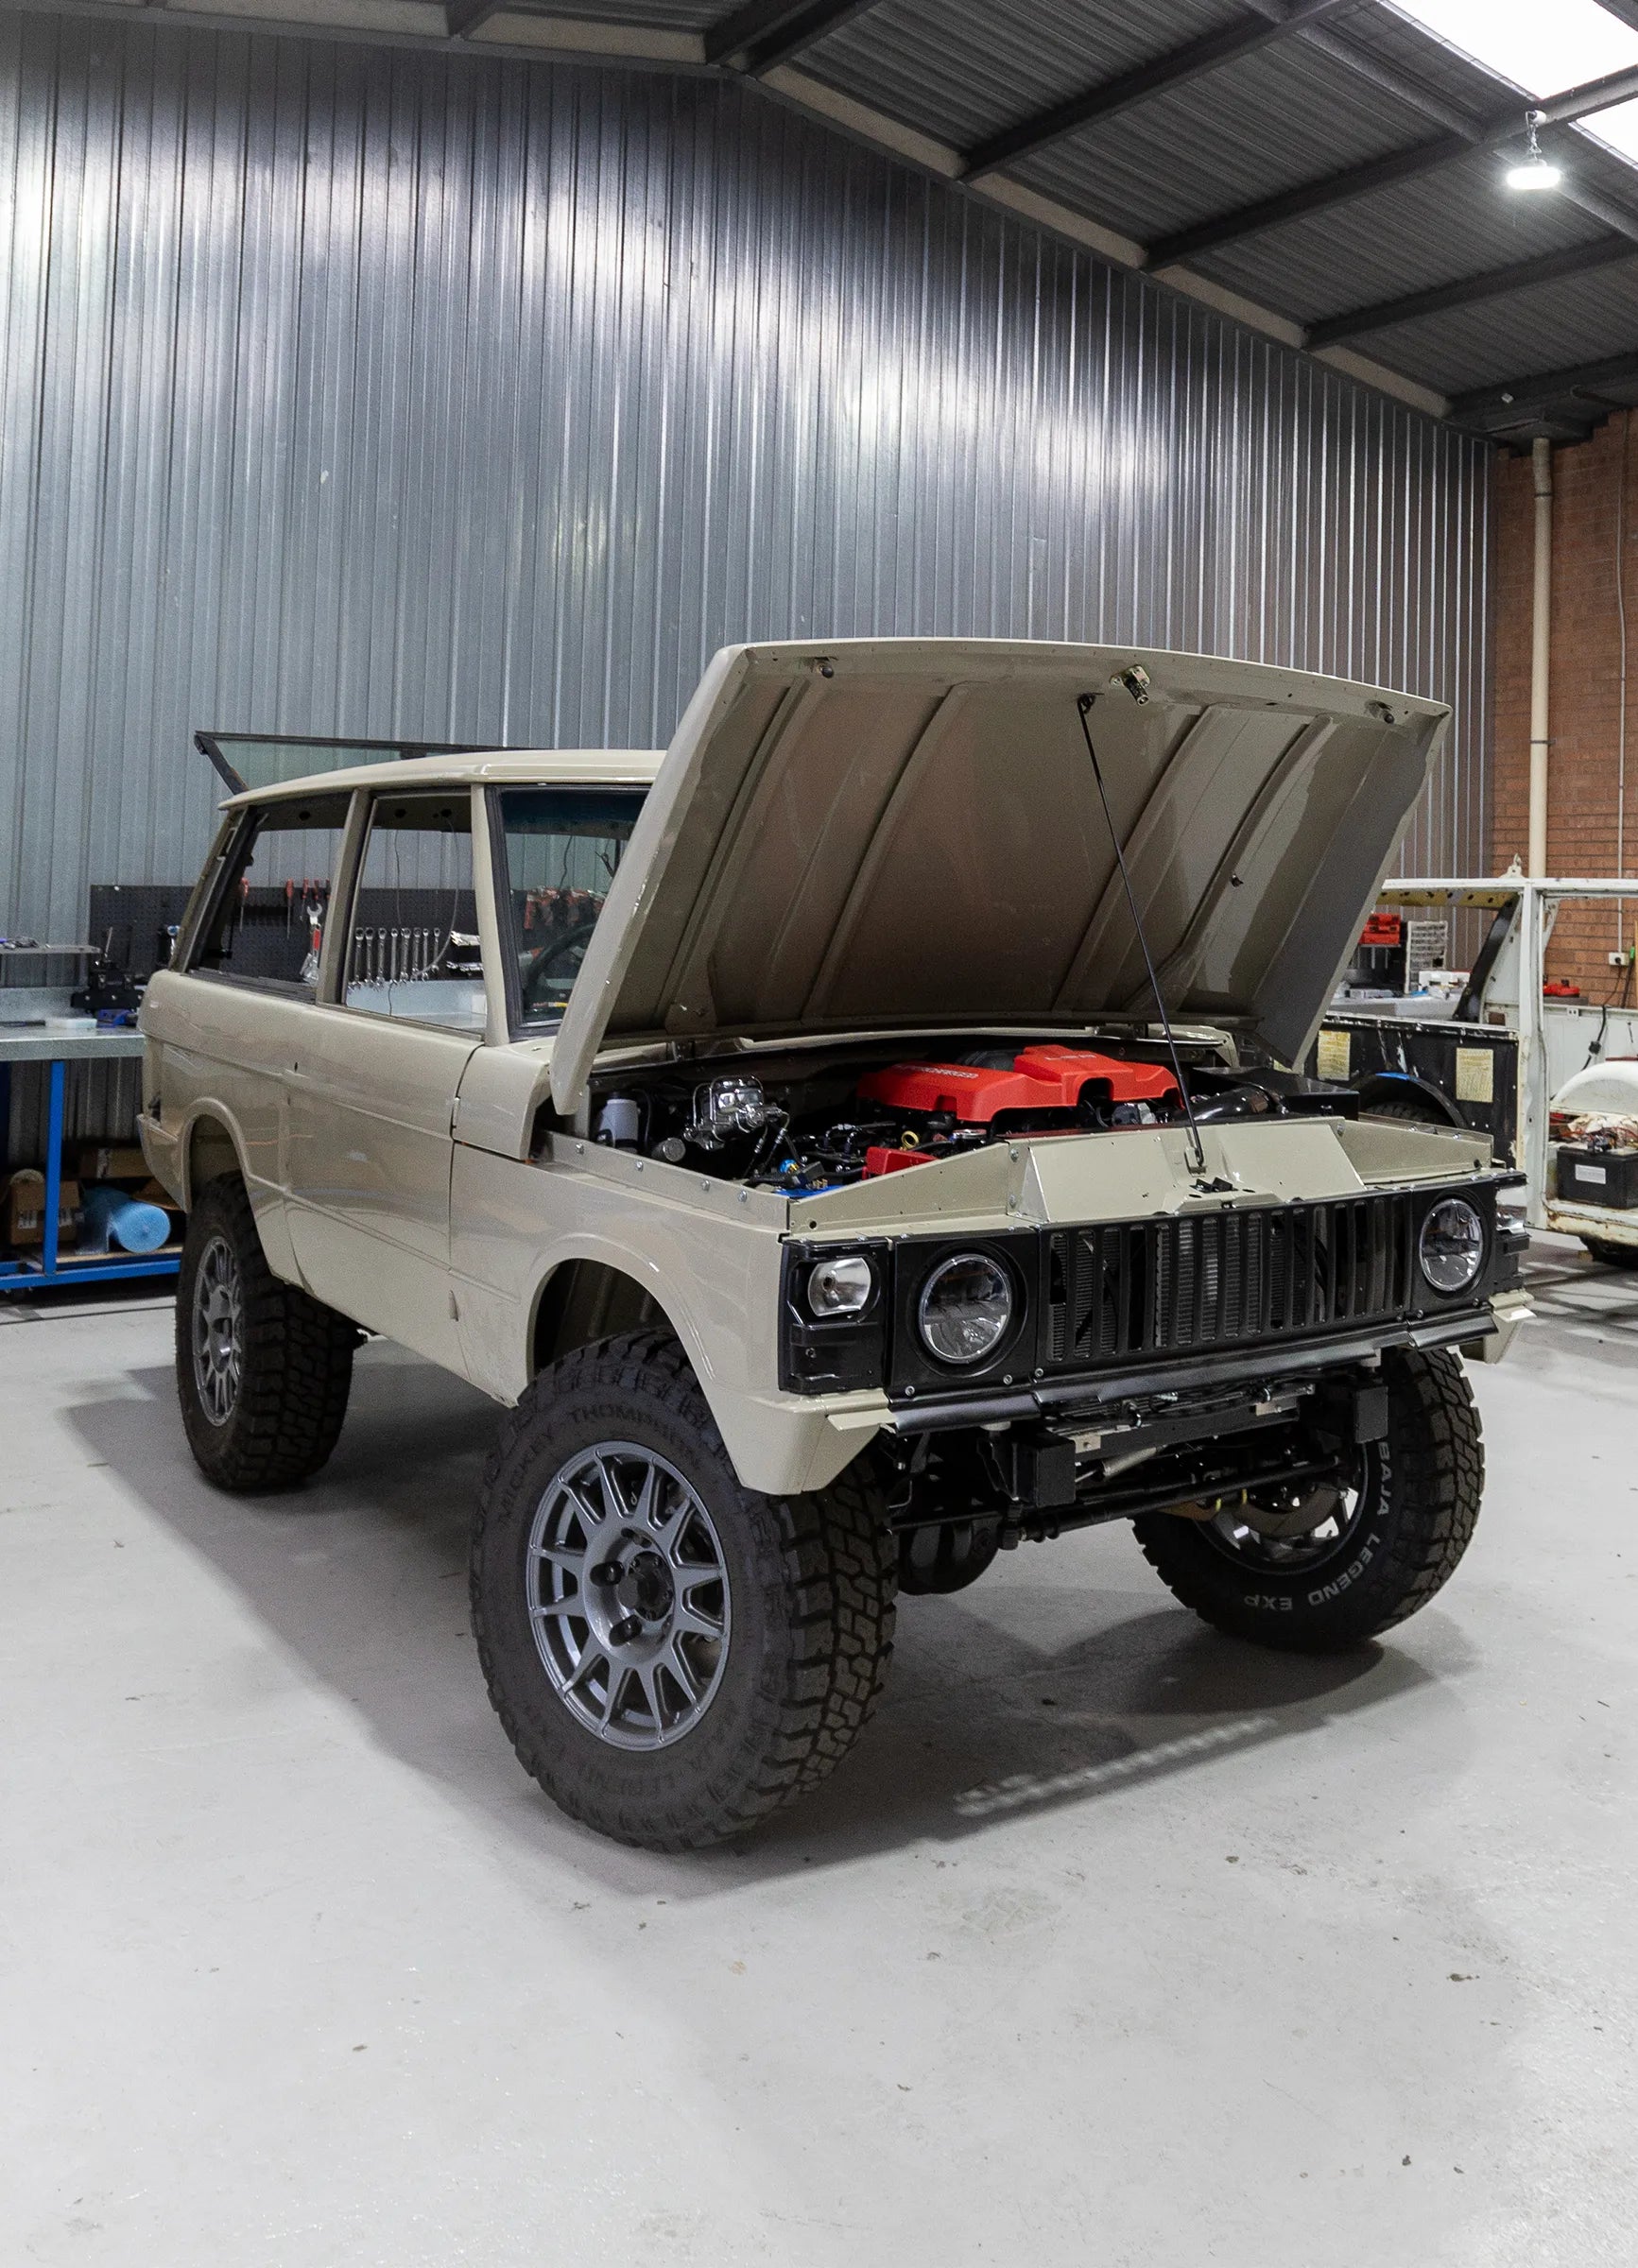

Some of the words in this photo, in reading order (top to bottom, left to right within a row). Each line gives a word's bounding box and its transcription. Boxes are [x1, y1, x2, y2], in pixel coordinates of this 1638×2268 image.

[1377, 1441, 1392, 1516] BAJA
[1243, 1594, 1294, 1611] EXP
[1307, 1532, 1381, 1606] LEGEND
